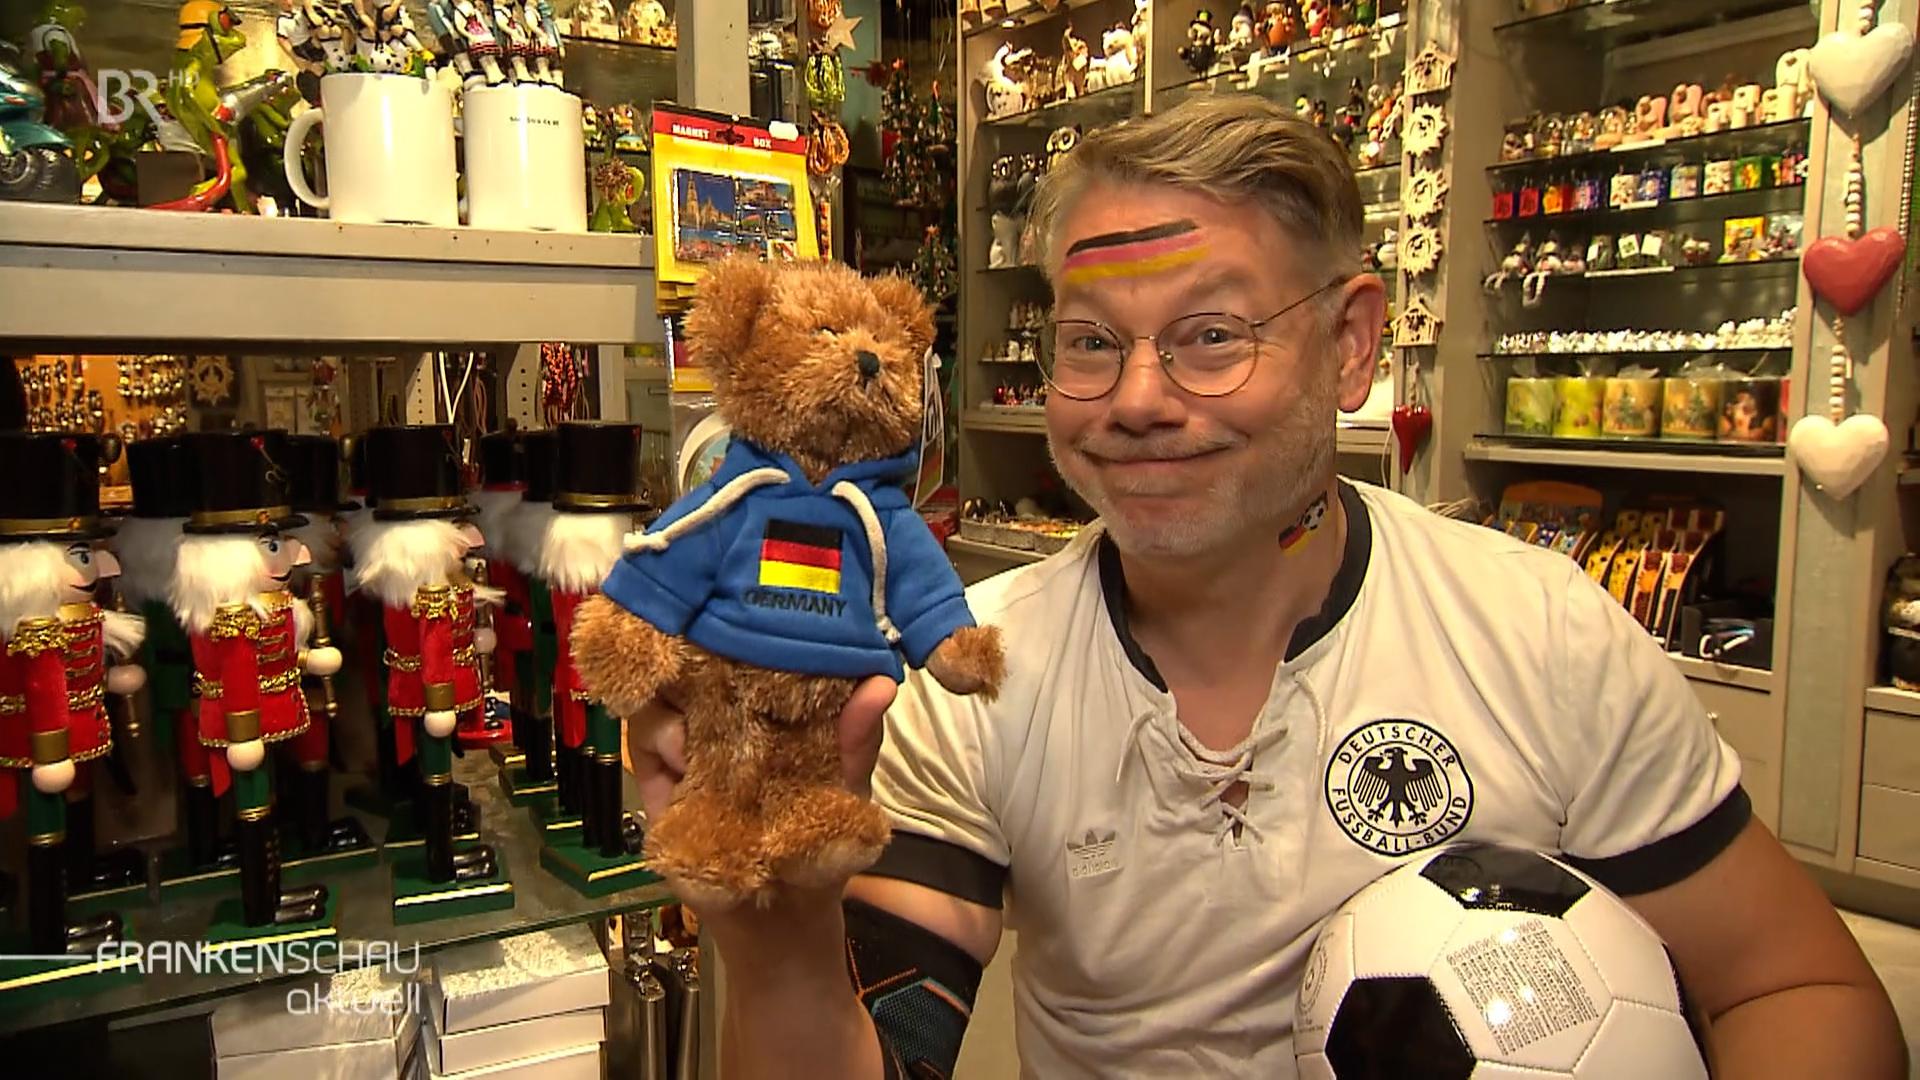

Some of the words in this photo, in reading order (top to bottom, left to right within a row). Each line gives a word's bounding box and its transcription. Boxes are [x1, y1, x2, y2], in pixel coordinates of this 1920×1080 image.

[753, 136, 772, 149] BOX
[744, 589, 847, 617] GERMANY
[1338, 724, 1456, 768] DEUTSCHER
